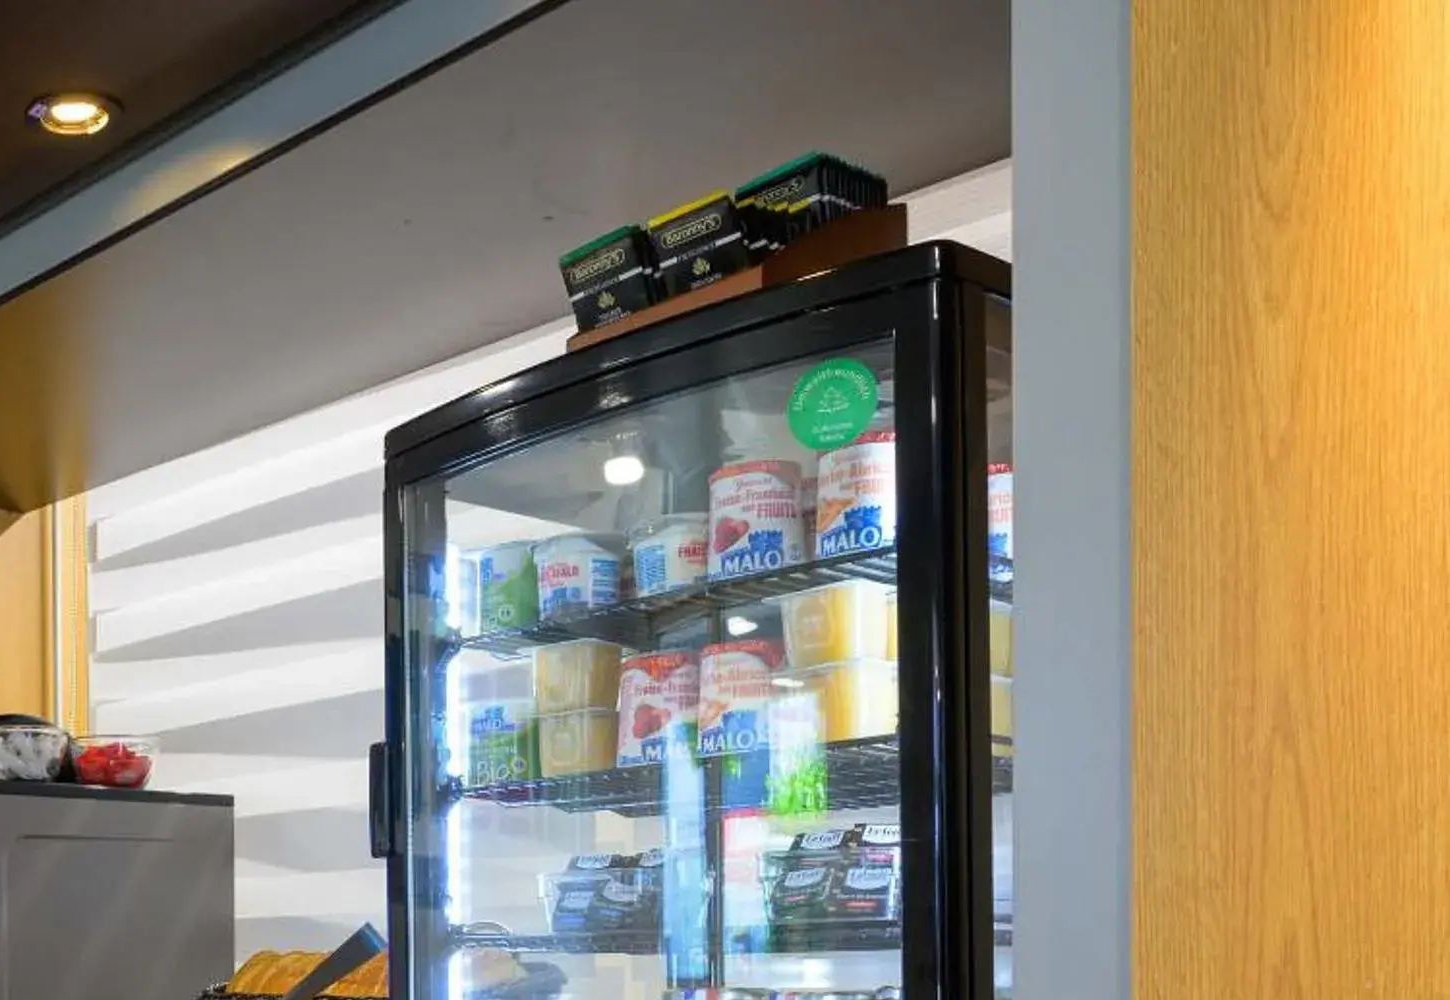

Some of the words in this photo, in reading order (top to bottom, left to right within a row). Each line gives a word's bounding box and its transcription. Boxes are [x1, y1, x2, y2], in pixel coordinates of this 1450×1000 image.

[822, 526, 881, 556] MALO
[723, 550, 782, 577] MALO
[703, 729, 755, 753] MALO
